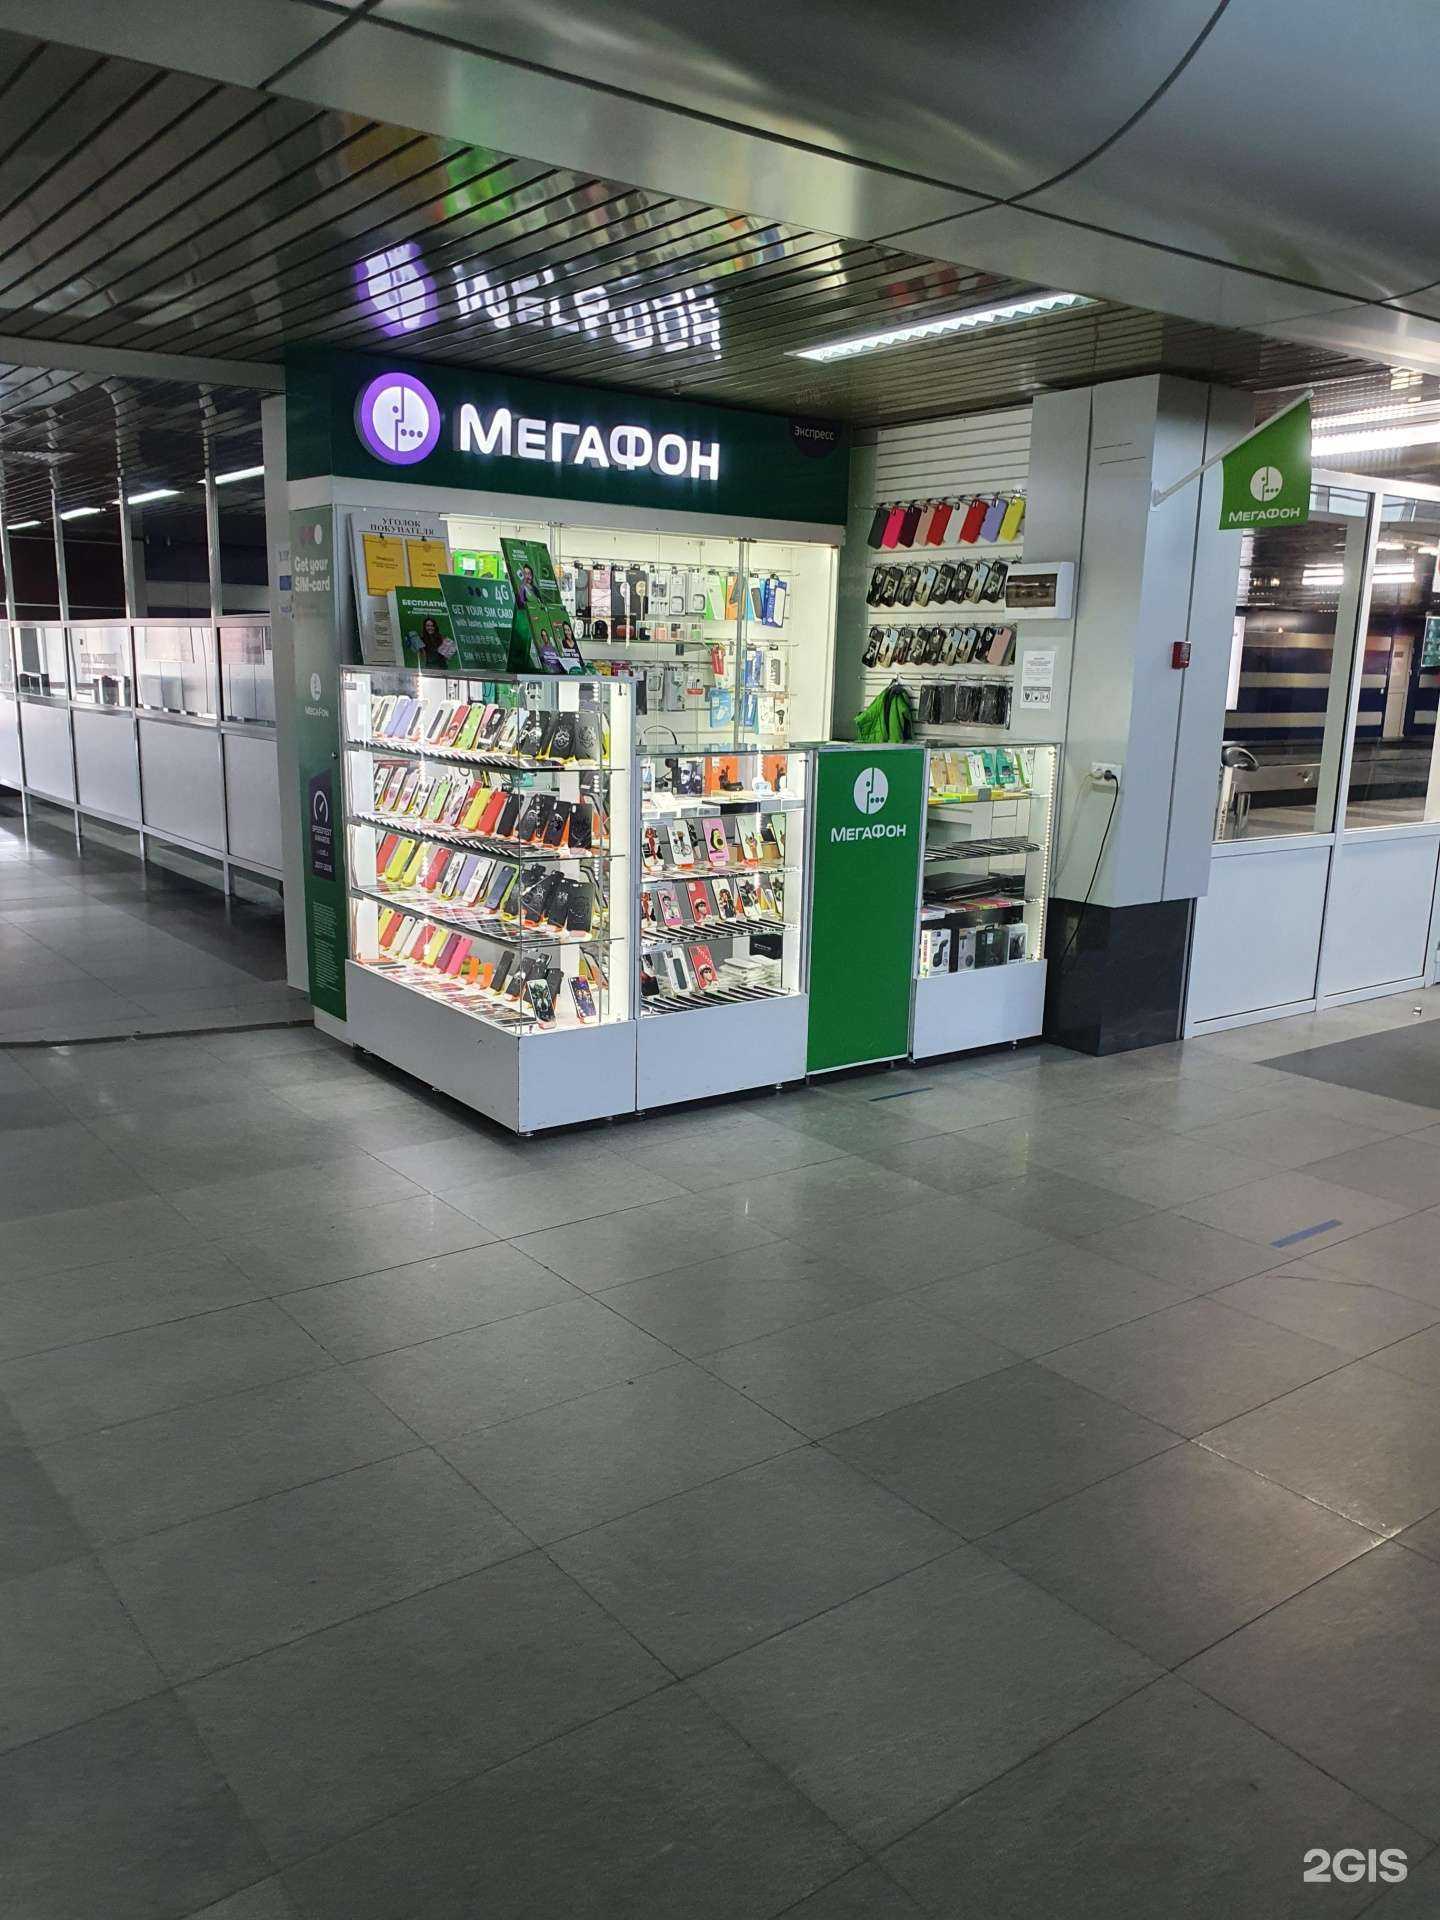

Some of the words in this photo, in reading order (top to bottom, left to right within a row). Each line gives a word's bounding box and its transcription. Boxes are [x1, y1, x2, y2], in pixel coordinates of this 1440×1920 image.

[459, 403, 720, 481] МЕГАФОН
[1228, 507, 1301, 523] МЕГАФОН
[295, 556, 309, 573] Get
[310, 559, 329, 575] your
[495, 584, 510, 605] 4G
[451, 604, 465, 615] GET
[466, 605, 484, 616] YOUR
[484, 607, 498, 618] SIM
[497, 608, 514, 619] CARD
[830, 823, 907, 843] МЕГАФОН
